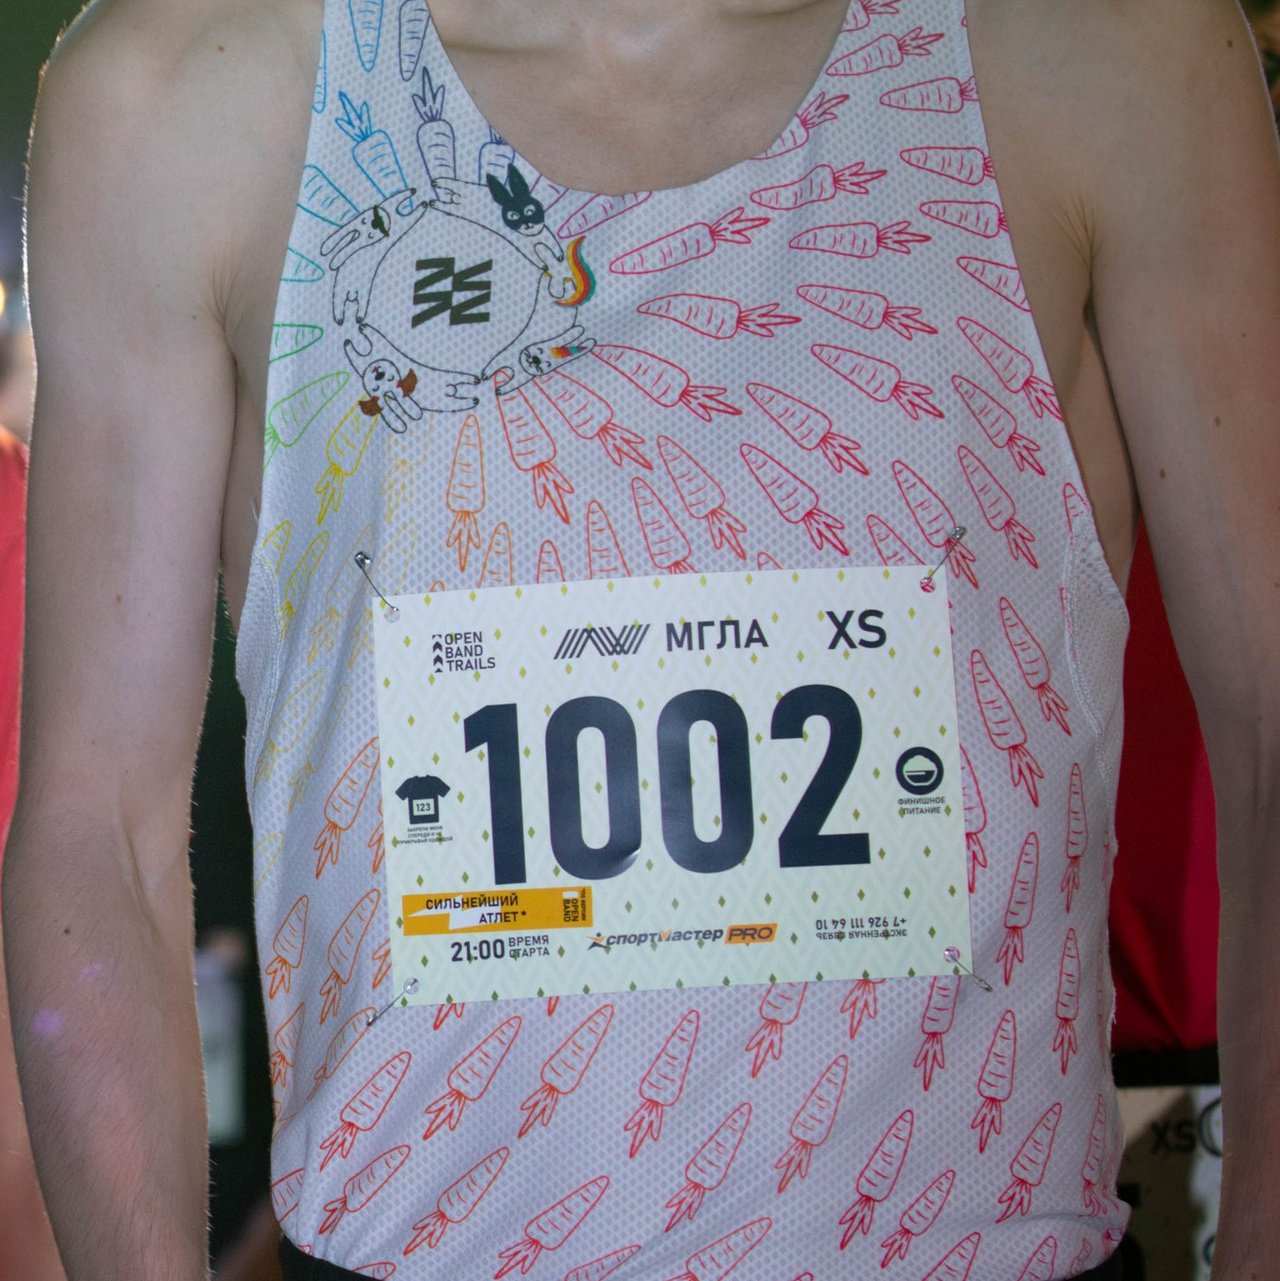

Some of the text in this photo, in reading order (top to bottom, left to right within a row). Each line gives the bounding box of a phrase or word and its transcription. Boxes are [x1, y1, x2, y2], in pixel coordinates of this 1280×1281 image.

[666, 619, 769, 652] МГЛА
[826, 609, 888, 650] XS
[444, 631, 483, 645] OPEN
[445, 645, 484, 659] BAND
[447, 657, 496, 672] TRAILS
[463, 684, 871, 885] 1002
[416, 802, 431, 812] 123
[897, 796, 946, 805] ФИНИШНОЕ
[902, 805, 942, 815] ПИТАНИЕ
[425, 892, 519, 910] СИЛЬНЕЙШИЙ
[563, 898, 571, 922] BAND
[571, 898, 579, 922] OPEN
[816, 916, 907, 930] +7 926 111 64 10
[508, 934, 549, 948] ВРЕМЯ
[727, 926, 775, 943] PRO
[450, 938, 505, 962] 21:00
[508, 946, 550, 958] СТАРТА
[1151, 1119, 1196, 1155] XS
